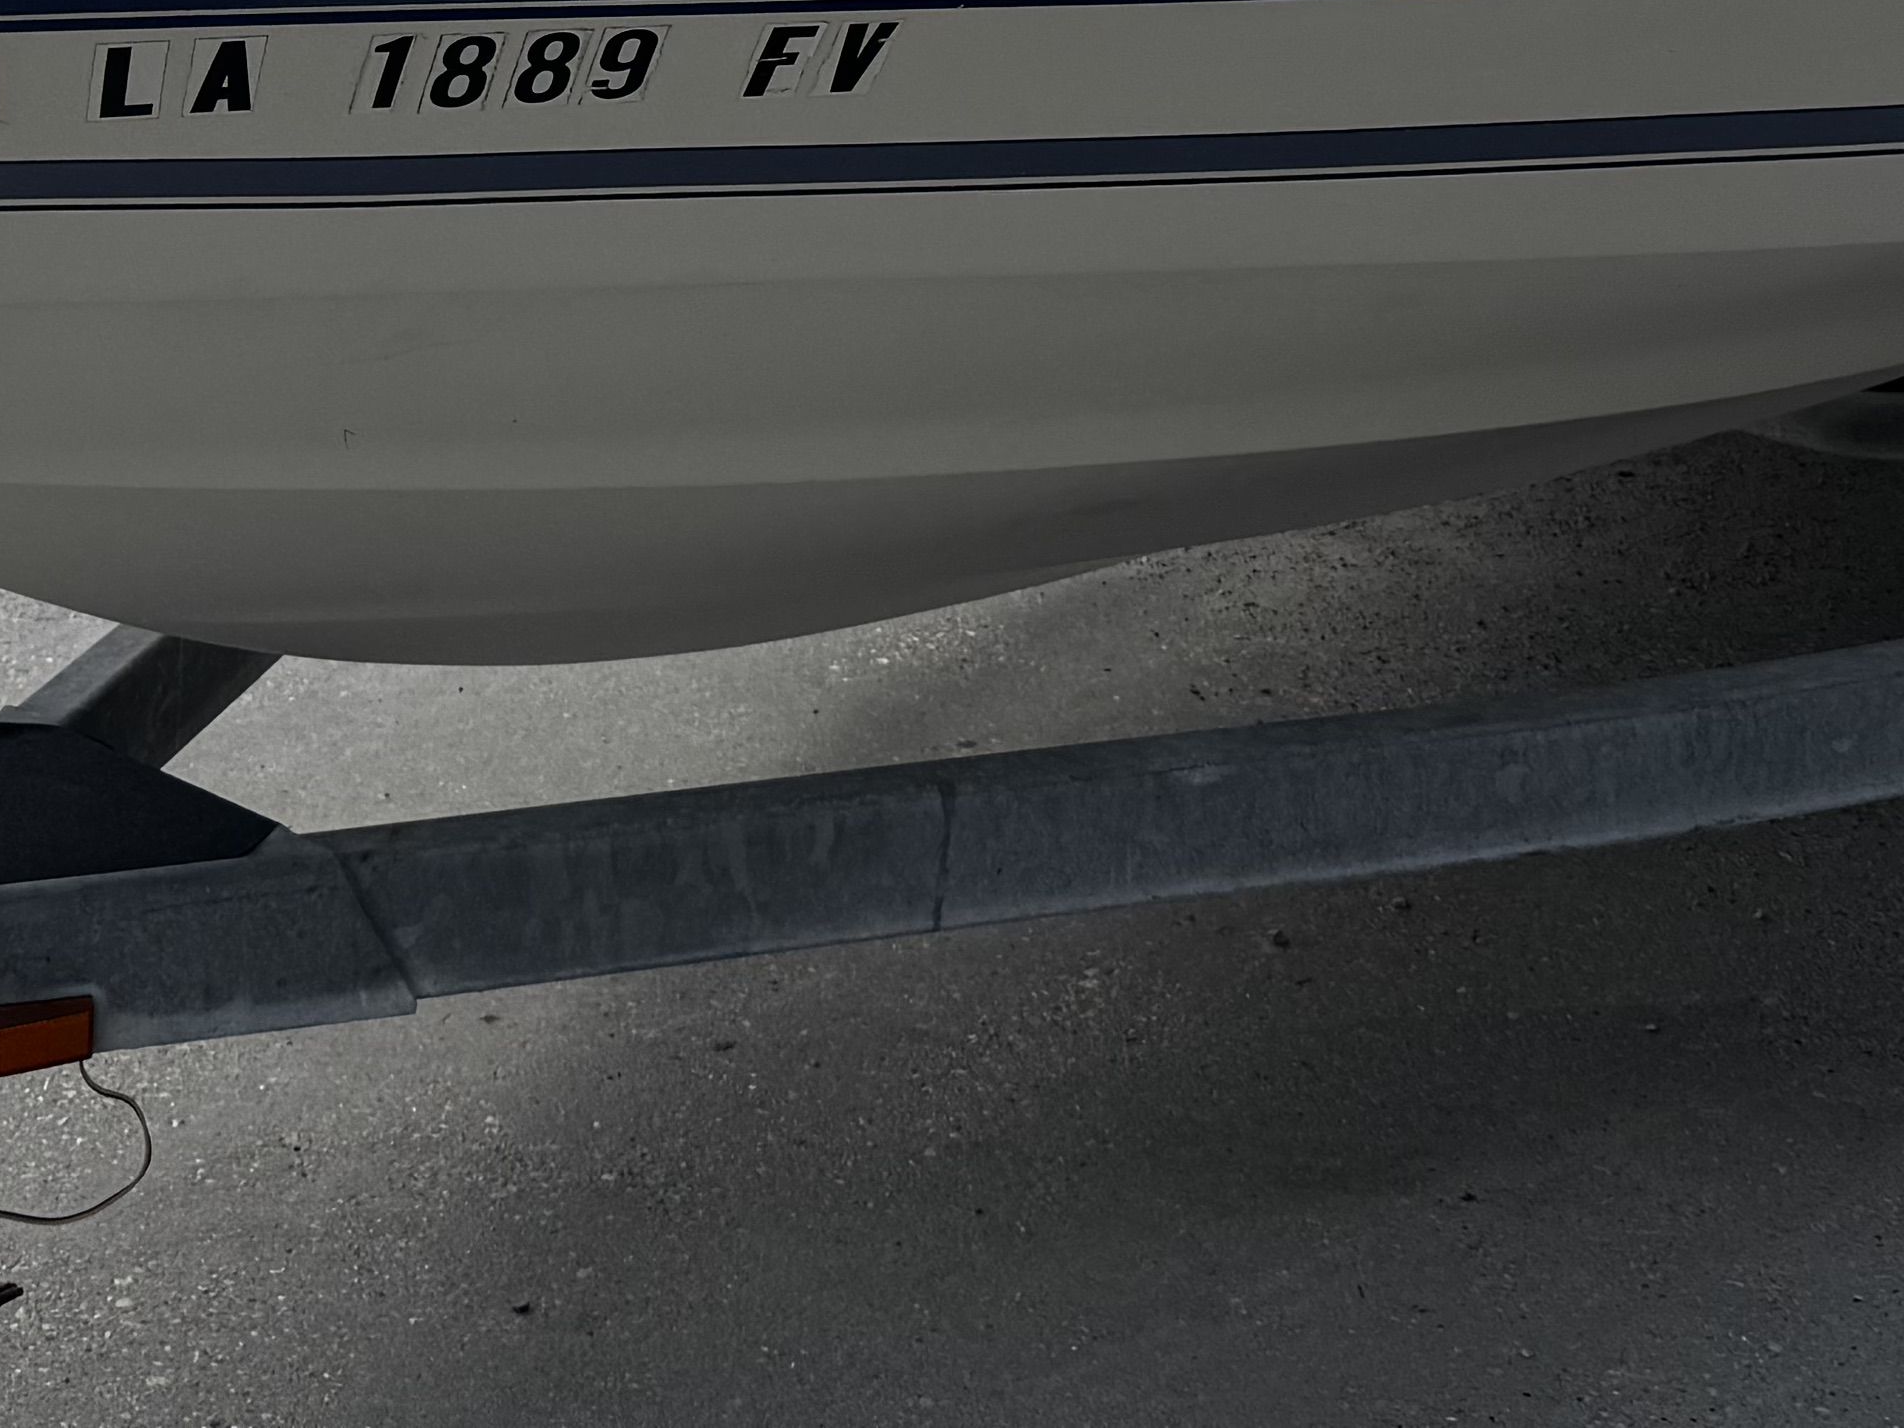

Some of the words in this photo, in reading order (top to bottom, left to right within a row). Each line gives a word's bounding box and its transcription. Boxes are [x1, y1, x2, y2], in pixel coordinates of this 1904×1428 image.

[99, 39, 254, 118] LA
[371, 28, 660, 109] 1889
[741, 21, 899, 97] FV
